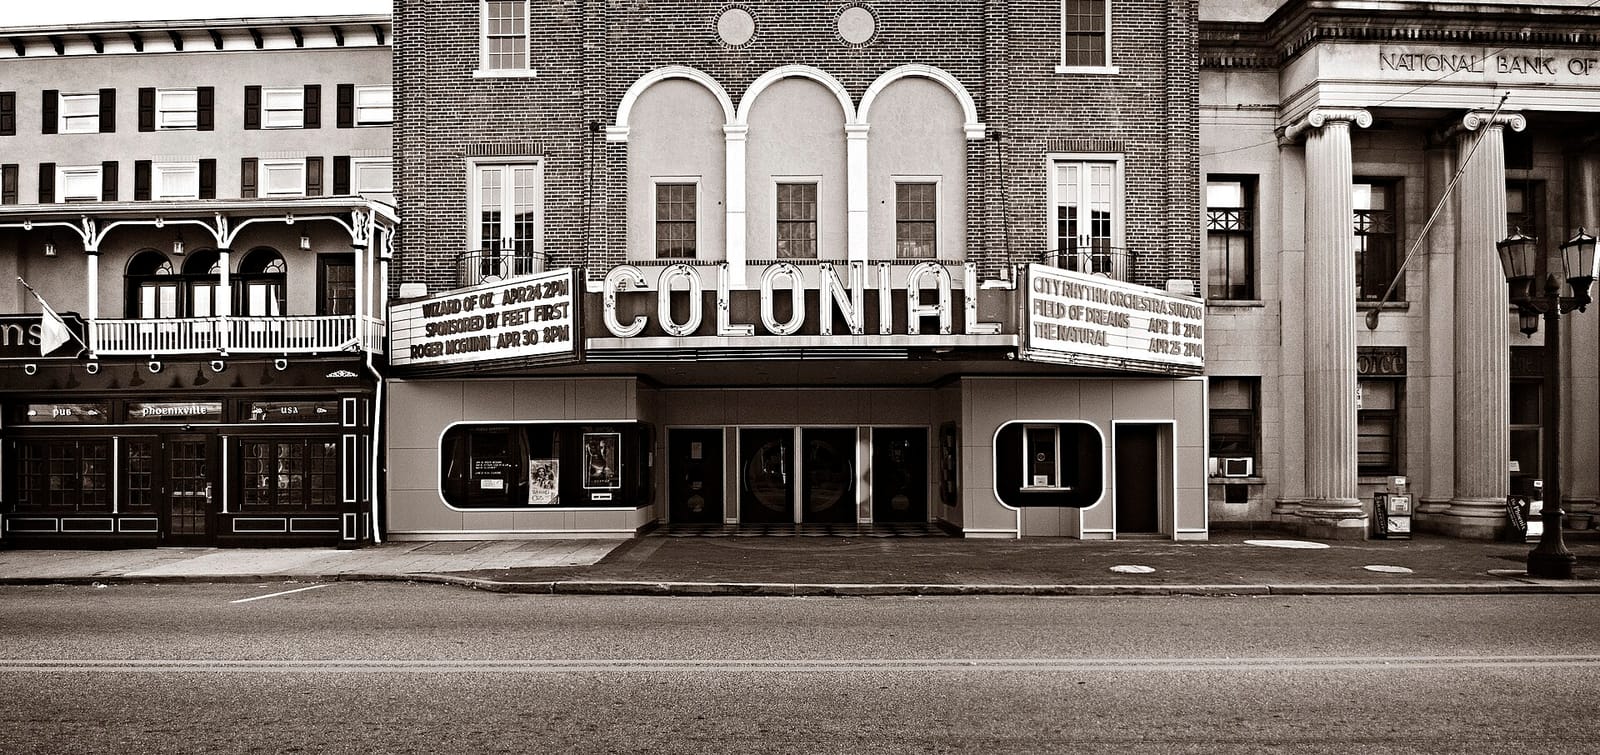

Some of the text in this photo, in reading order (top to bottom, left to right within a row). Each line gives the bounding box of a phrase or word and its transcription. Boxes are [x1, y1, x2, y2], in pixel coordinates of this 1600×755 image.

[1380, 53, 1598, 76] NATIONAL BANK OF
[422, 298, 461, 319] WIZARD
[463, 295, 478, 312] OF
[479, 292, 495, 309] OZ
[543, 279, 569, 298] 2PM
[603, 262, 1001, 337] COLONIAL
[1033, 276, 1060, 296] CITY
[1062, 280, 1109, 305] RHYTHM
[1109, 290, 1168, 315] ORCHESTRA
[425, 301, 570, 337] SPONSORED BY FEET FIRST
[1033, 298, 1066, 319] FIELD
[1068, 305, 1084, 321] OF
[1085, 306, 1130, 329] DREAMS
[1147, 317, 1169, 335] APR
[410, 324, 570, 359] ROGER MCGUINN APR 30 8PM
[1033, 320, 1057, 341] THE
[1057, 324, 1110, 347] NATURAL
[1148, 338, 1169, 354] APR
